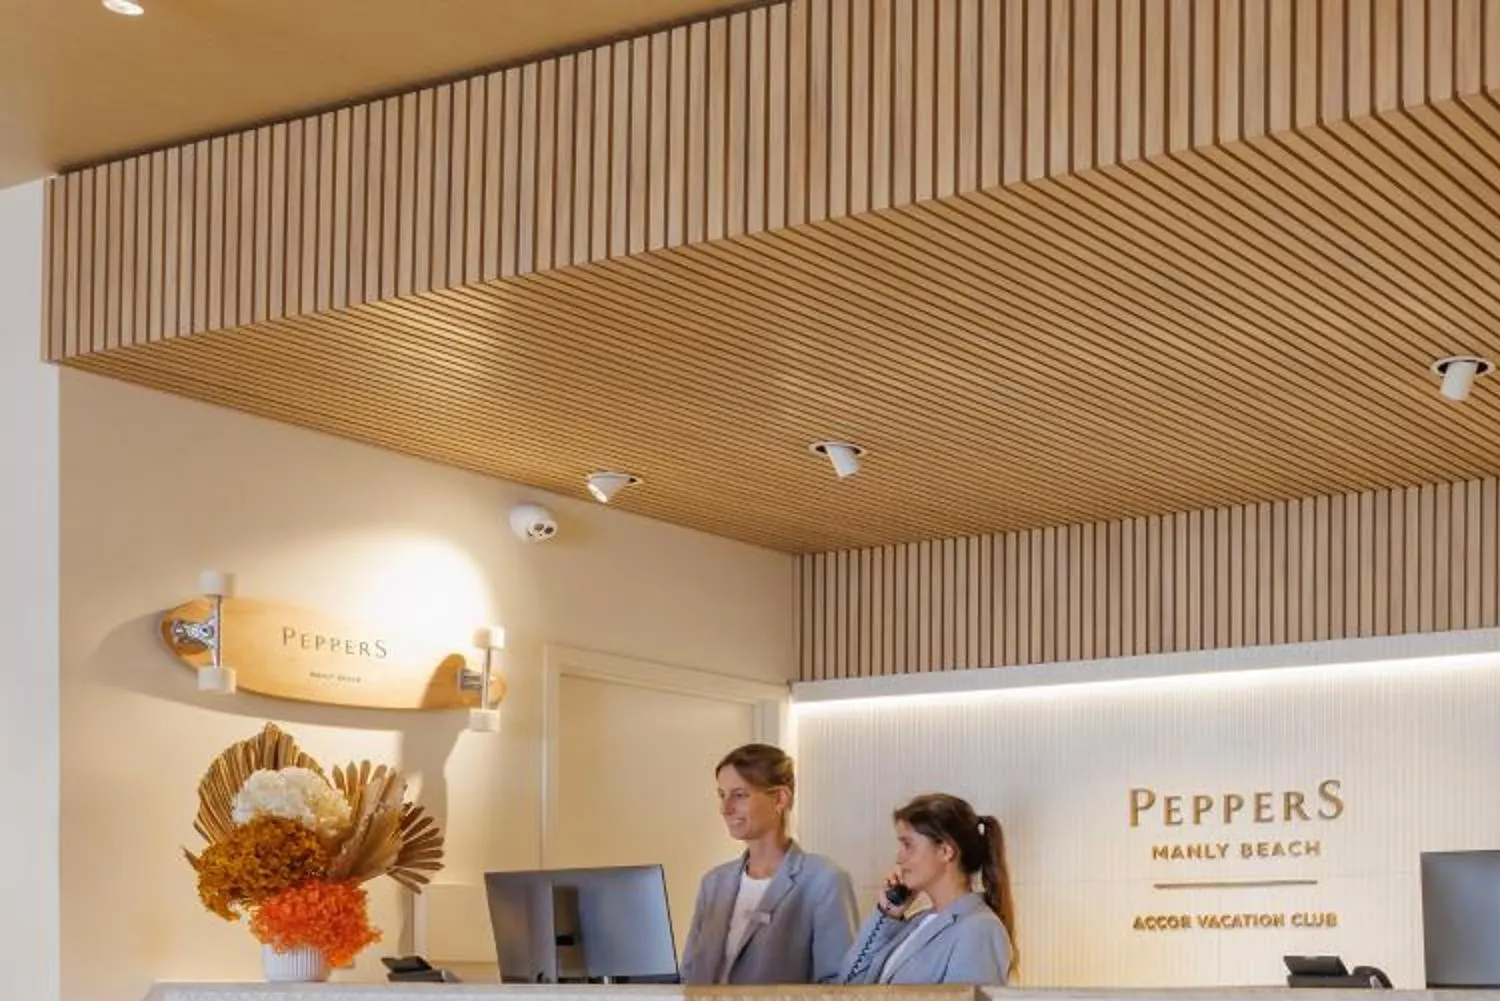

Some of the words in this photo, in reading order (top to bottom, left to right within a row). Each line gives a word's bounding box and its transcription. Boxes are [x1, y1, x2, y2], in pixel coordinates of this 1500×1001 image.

[282, 626, 387, 659] PEPPERS
[1129, 780, 1344, 827] PEPPERS
[1153, 843, 1230, 861] MANLY
[1241, 840, 1321, 859] BEACH
[1133, 915, 1192, 930] ACCOR
[1197, 914, 1285, 930] VACATION
[1291, 912, 1338, 928] CLUB
